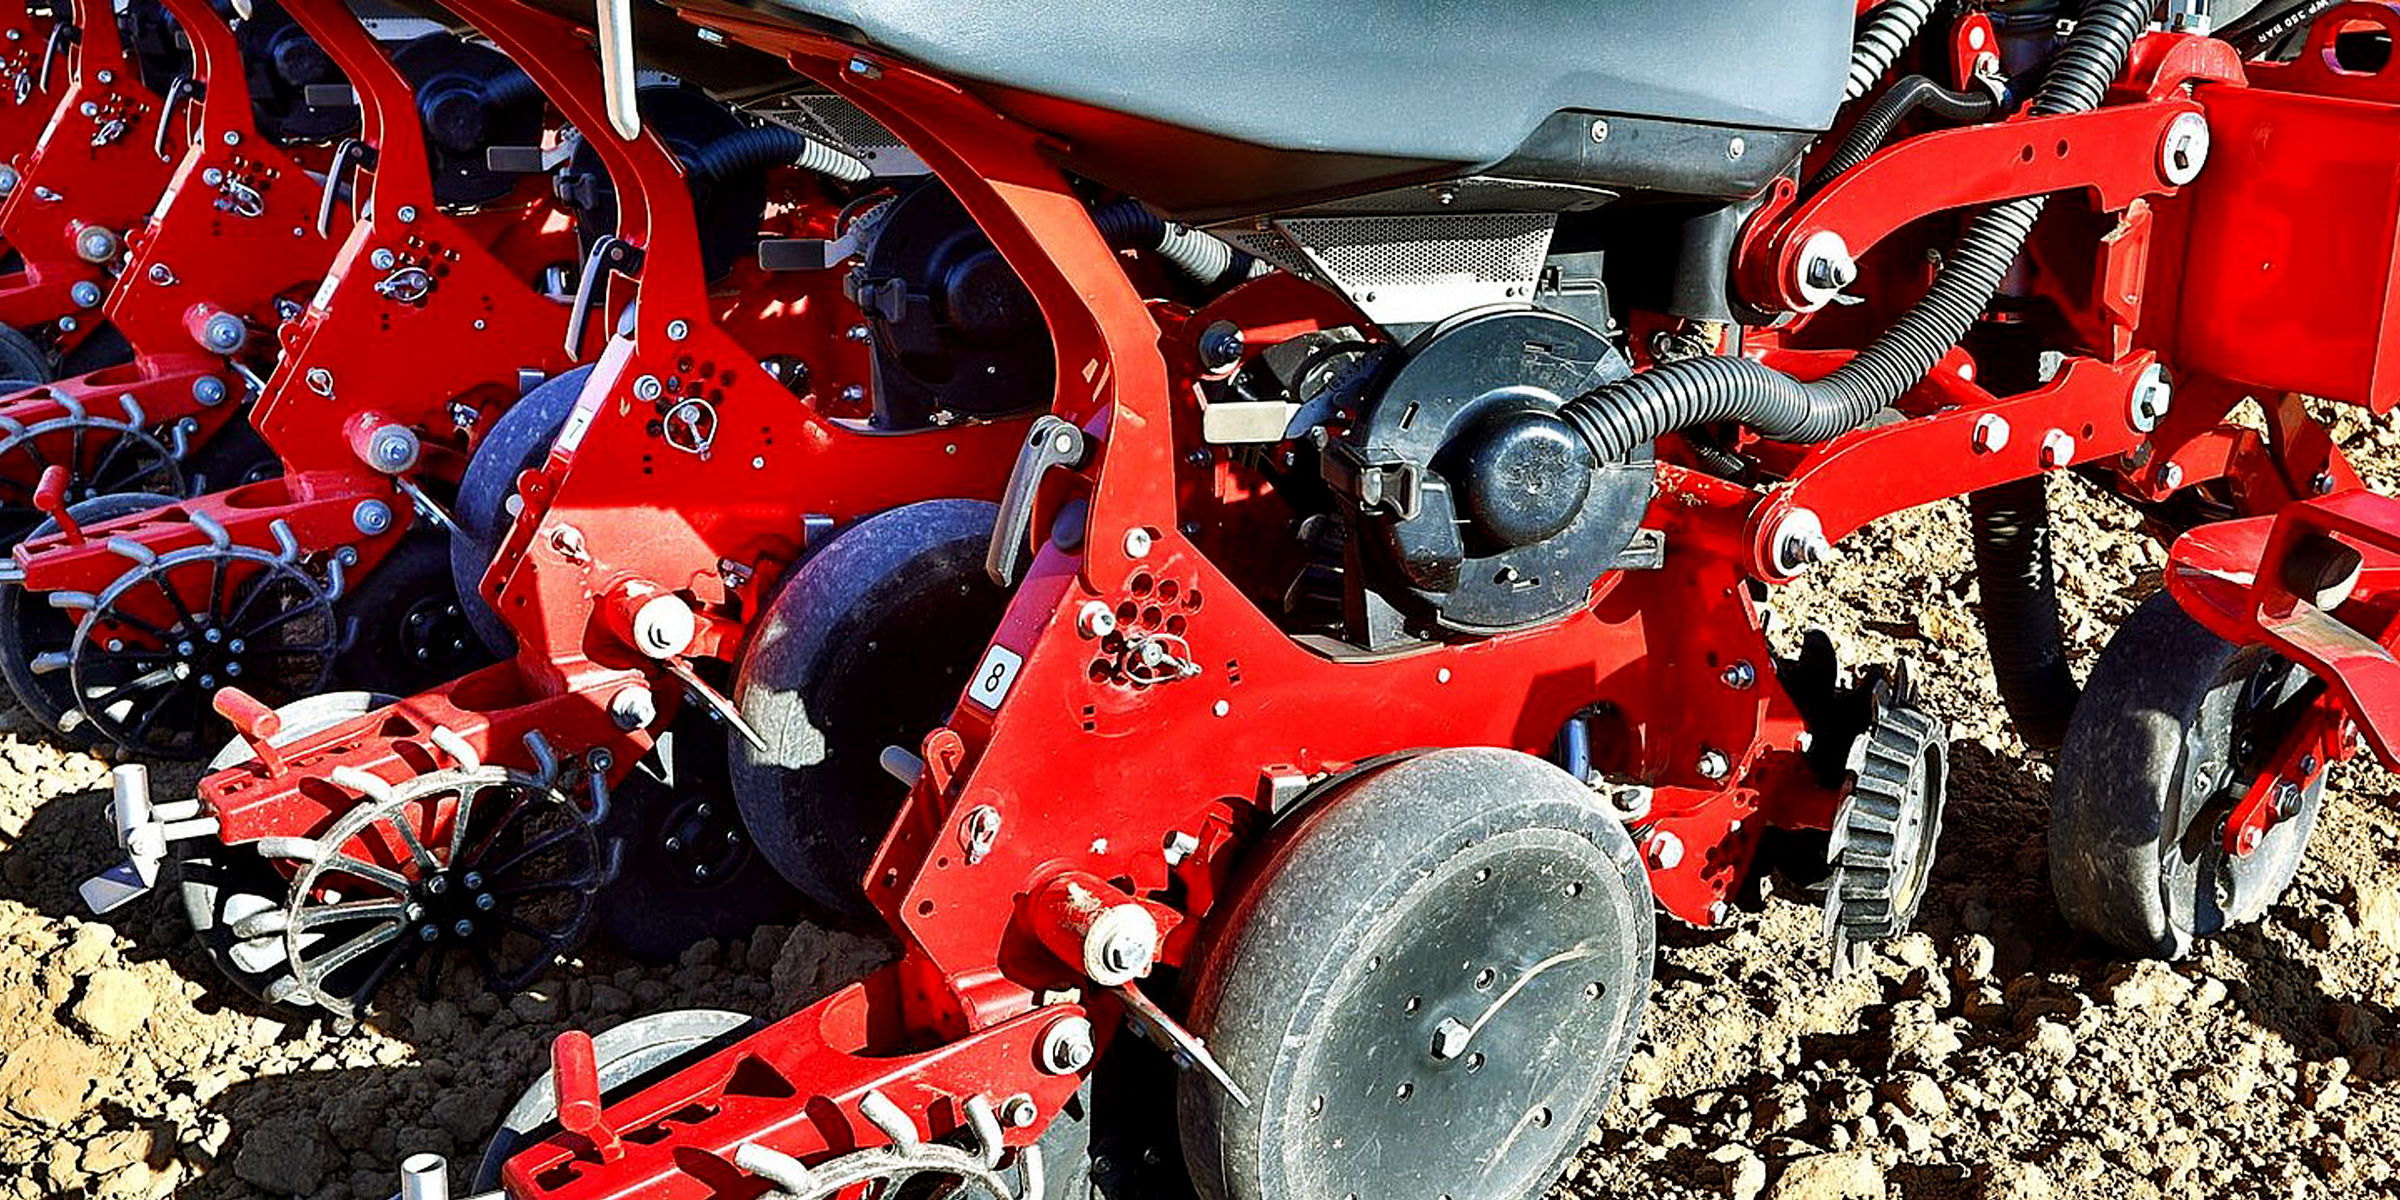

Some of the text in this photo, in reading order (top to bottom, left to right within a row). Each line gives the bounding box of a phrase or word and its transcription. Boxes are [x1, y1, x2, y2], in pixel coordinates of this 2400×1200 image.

[2284, 10, 2306, 28] 350
[2257, 23, 2283, 43] BAR
[985, 663, 1005, 692] 8
